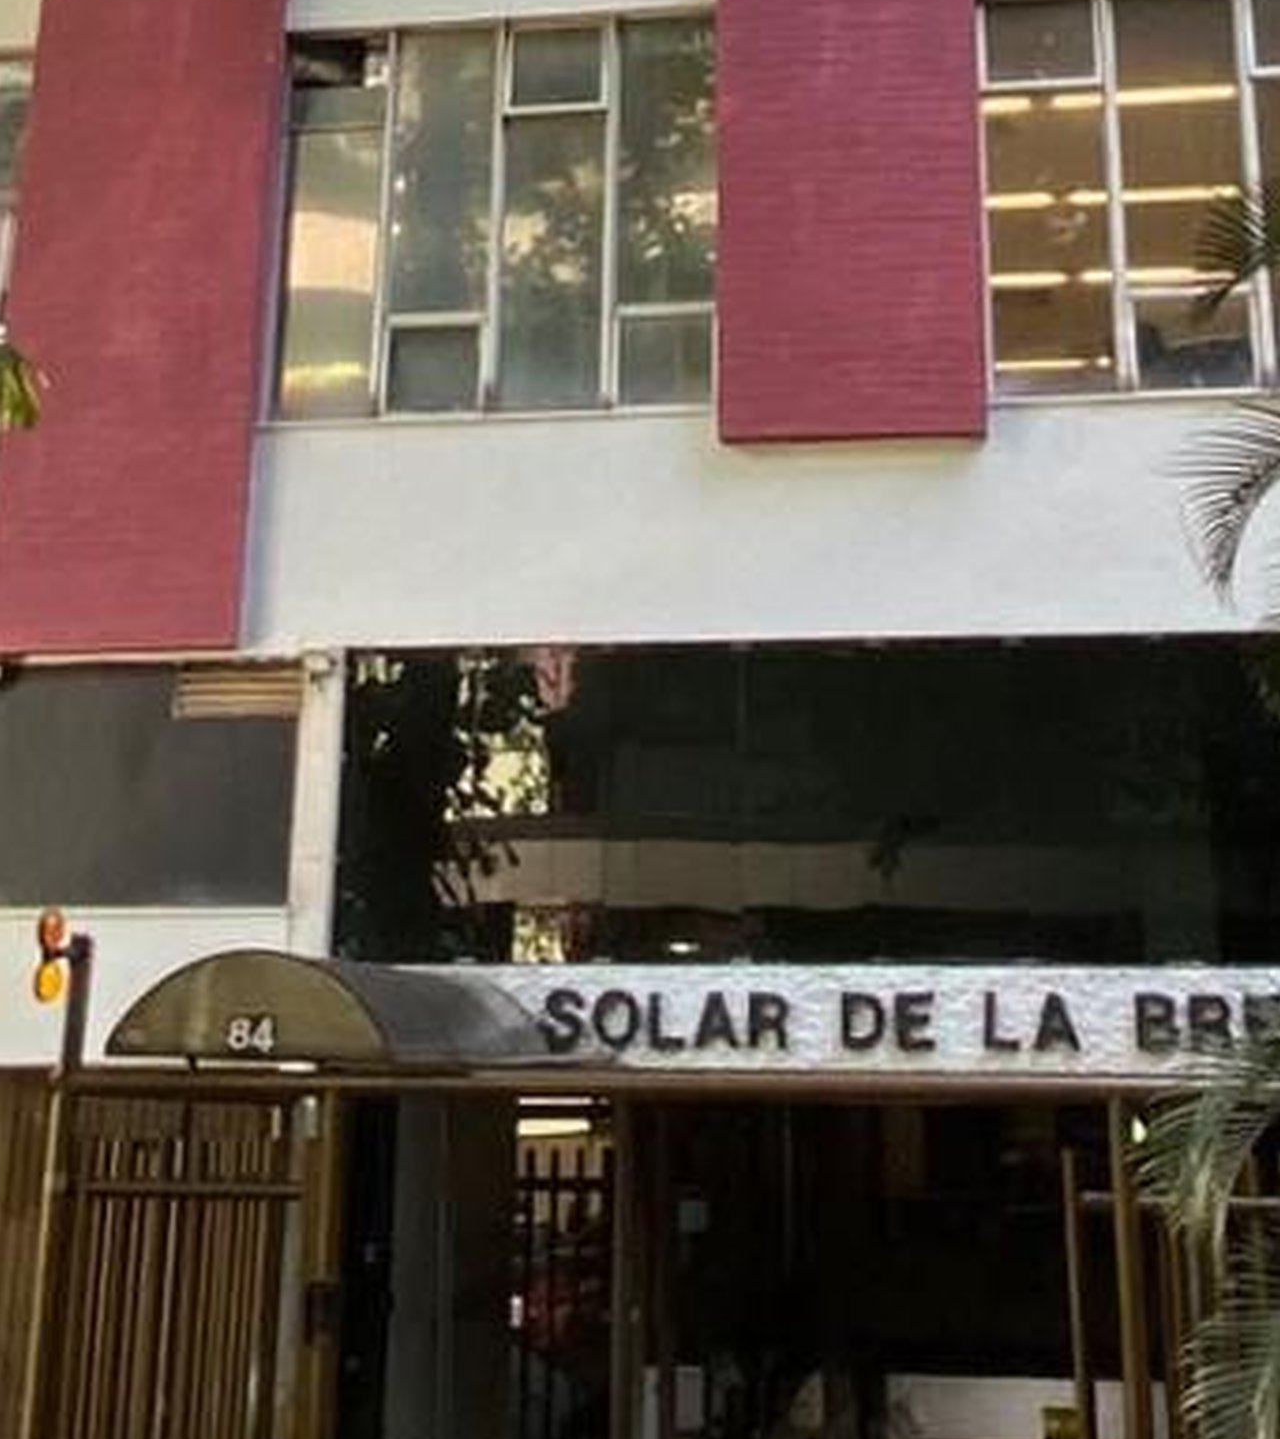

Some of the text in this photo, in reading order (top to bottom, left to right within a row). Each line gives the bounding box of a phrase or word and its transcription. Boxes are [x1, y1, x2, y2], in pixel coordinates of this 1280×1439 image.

[227, 1016, 275, 1053] 84
[542, 988, 790, 1053] SOLAR
[840, 990, 936, 1053] DE
[983, 990, 1081, 1053] LA
